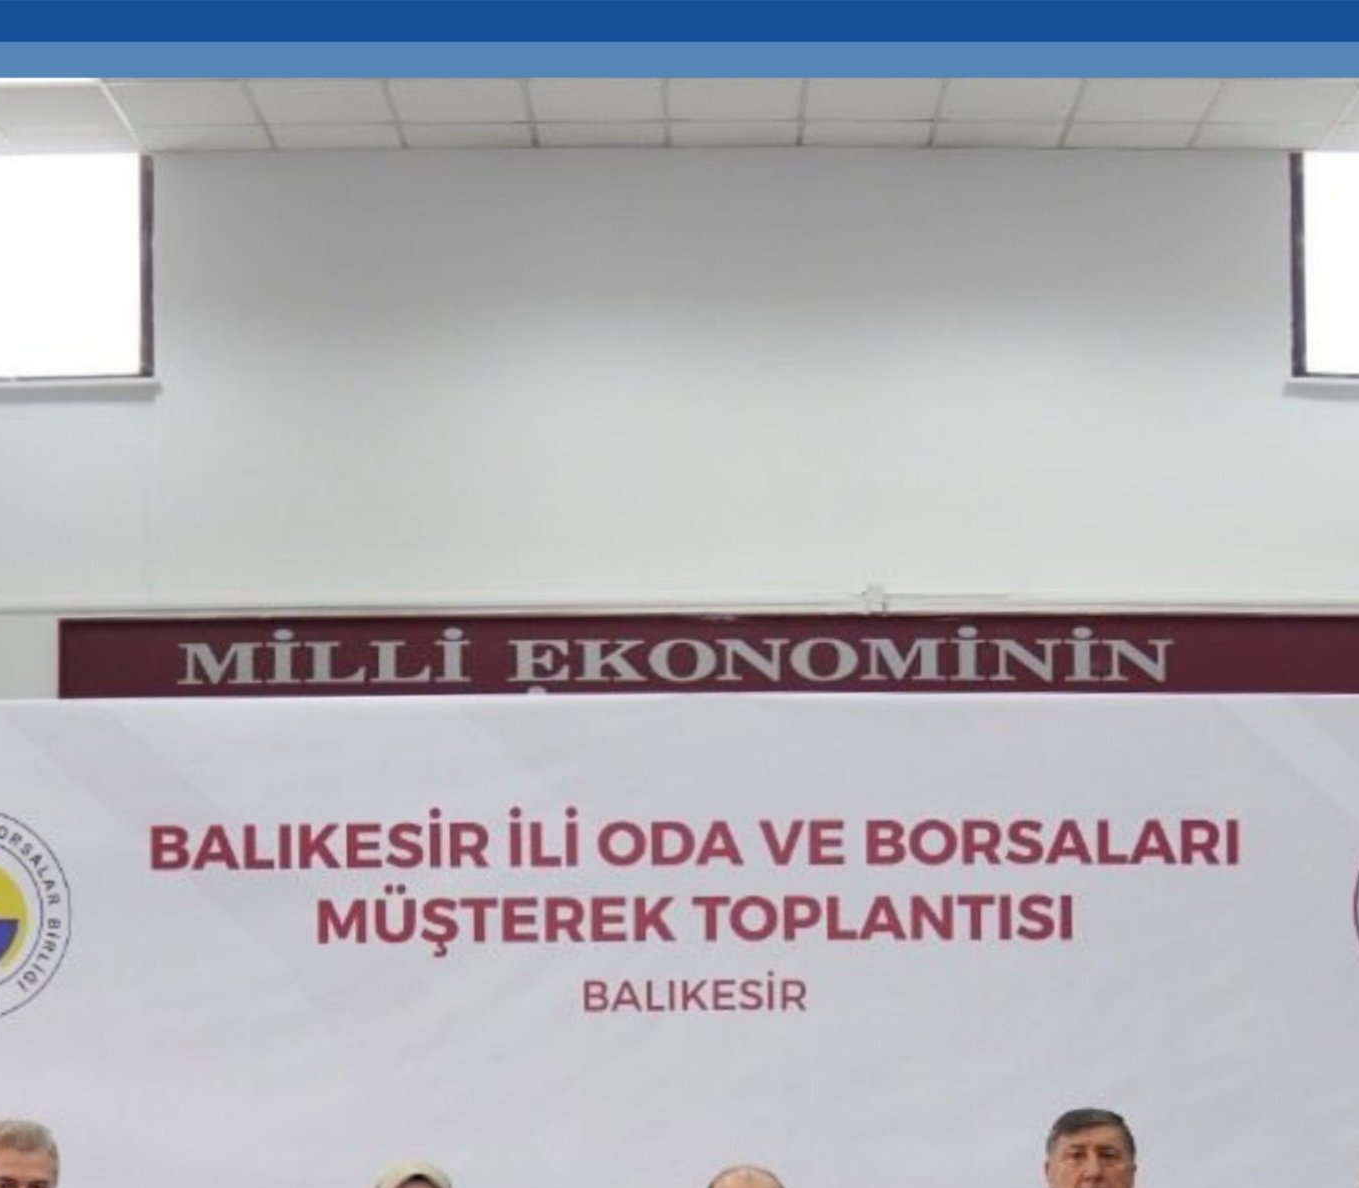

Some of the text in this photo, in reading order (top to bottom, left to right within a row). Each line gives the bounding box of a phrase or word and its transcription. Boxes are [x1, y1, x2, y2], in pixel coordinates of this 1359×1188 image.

[177, 623, 1173, 685] MİLLİ EKONOMİNİN
[150, 807, 1240, 870] BALIKESİR İLİ ODA VE BORSALARI
[316, 884, 1074, 956] MÜŞTEREK TOPLANTISI
[582, 970, 807, 1013] BALIKESİR
